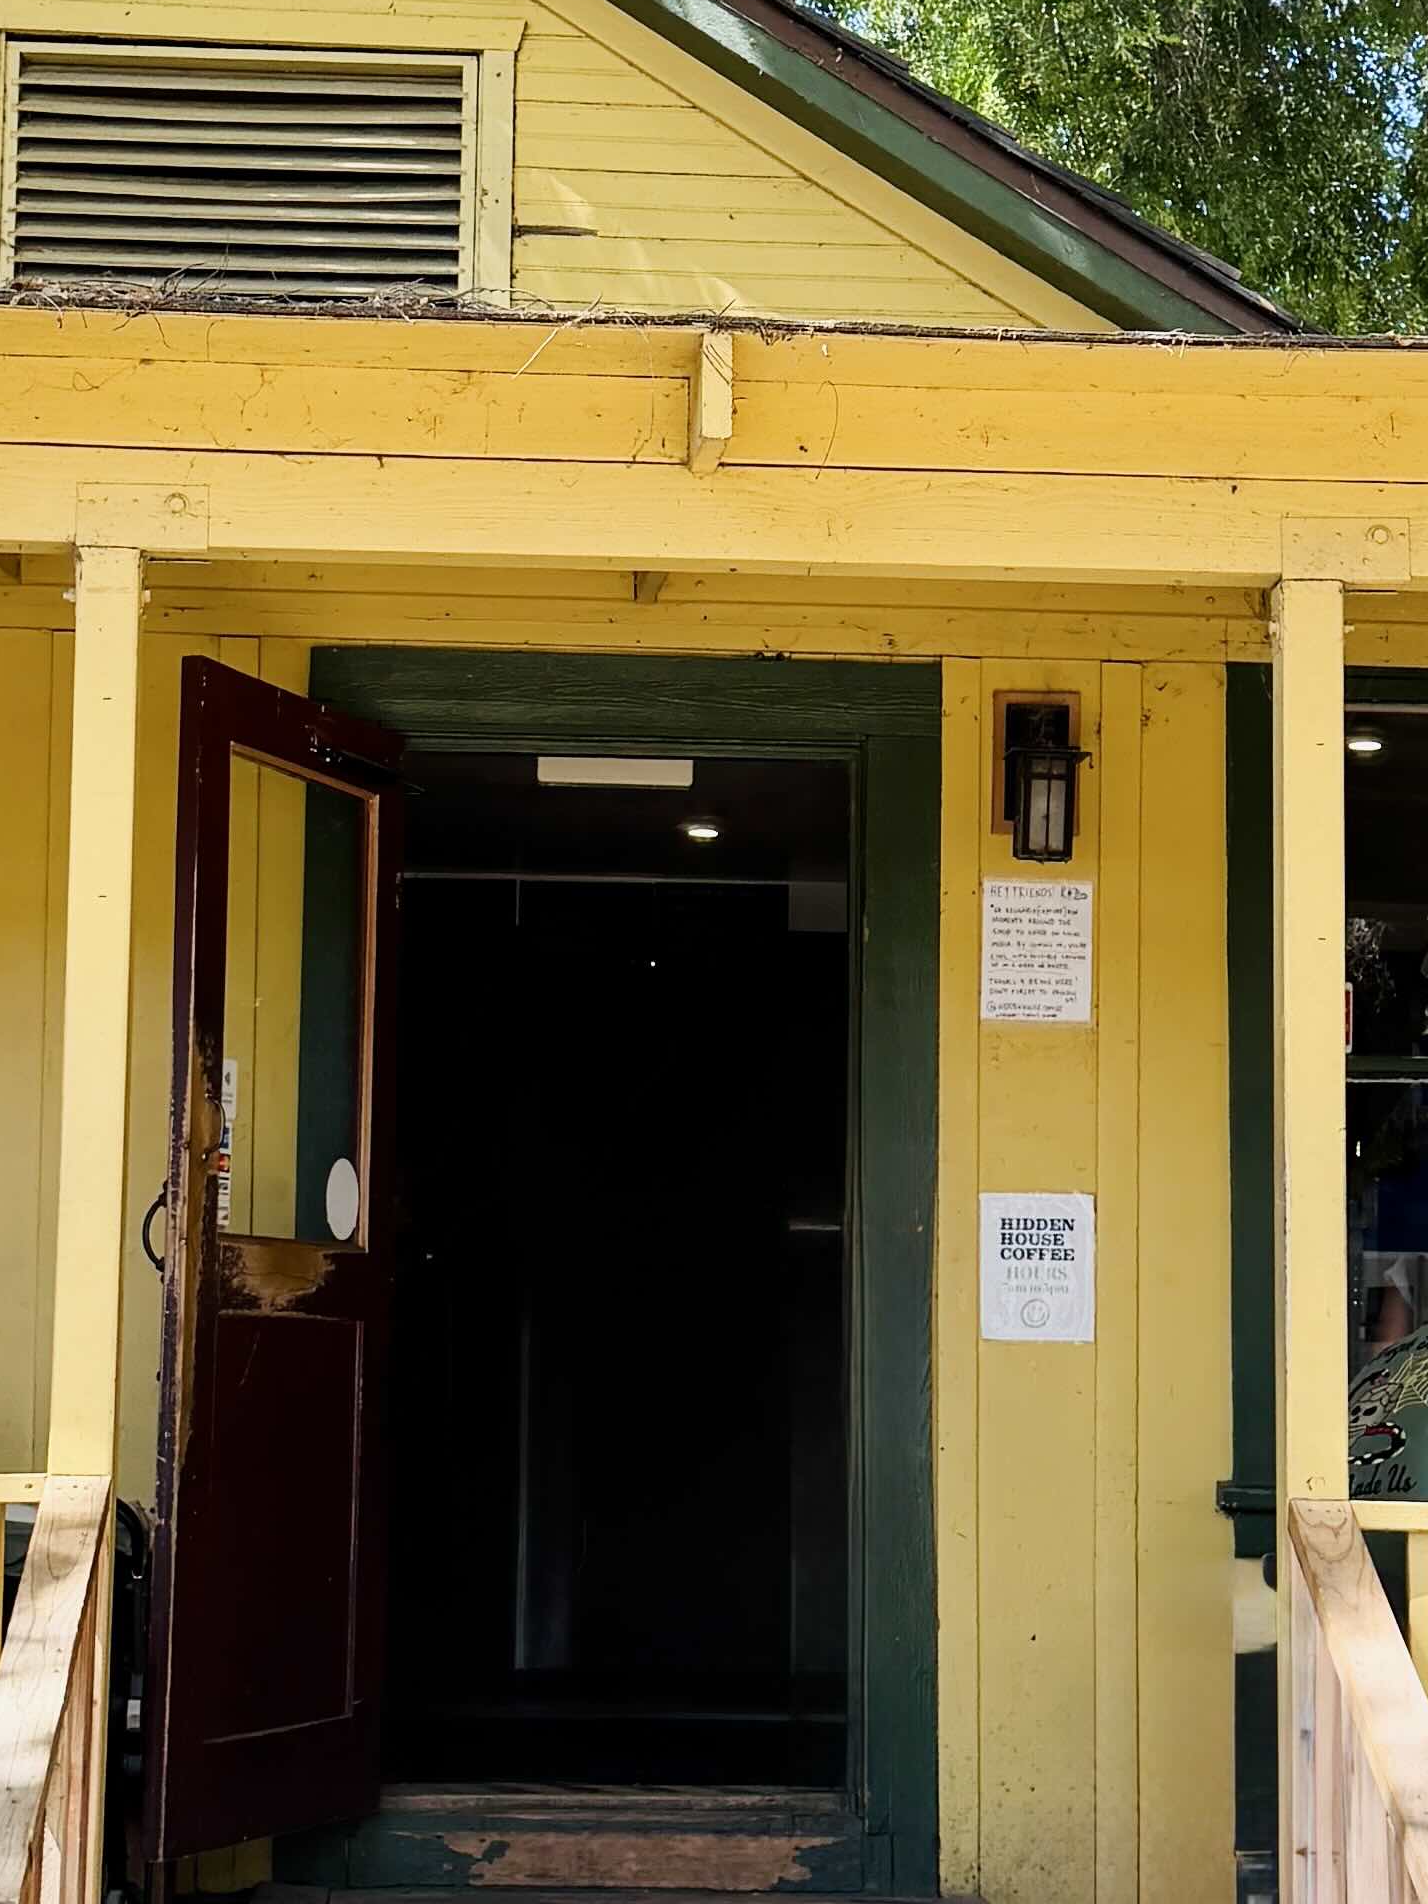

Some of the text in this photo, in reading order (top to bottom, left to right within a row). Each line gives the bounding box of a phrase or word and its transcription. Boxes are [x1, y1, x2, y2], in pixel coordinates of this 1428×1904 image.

[1000, 1218, 1075, 1231] HIDDEN
[1000, 1232, 1065, 1246] HOUSE
[1000, 1247, 1075, 1261] COFFEE
[1006, 1266, 1068, 1281] HOURS
[1387, 1463, 1418, 1494] Us
